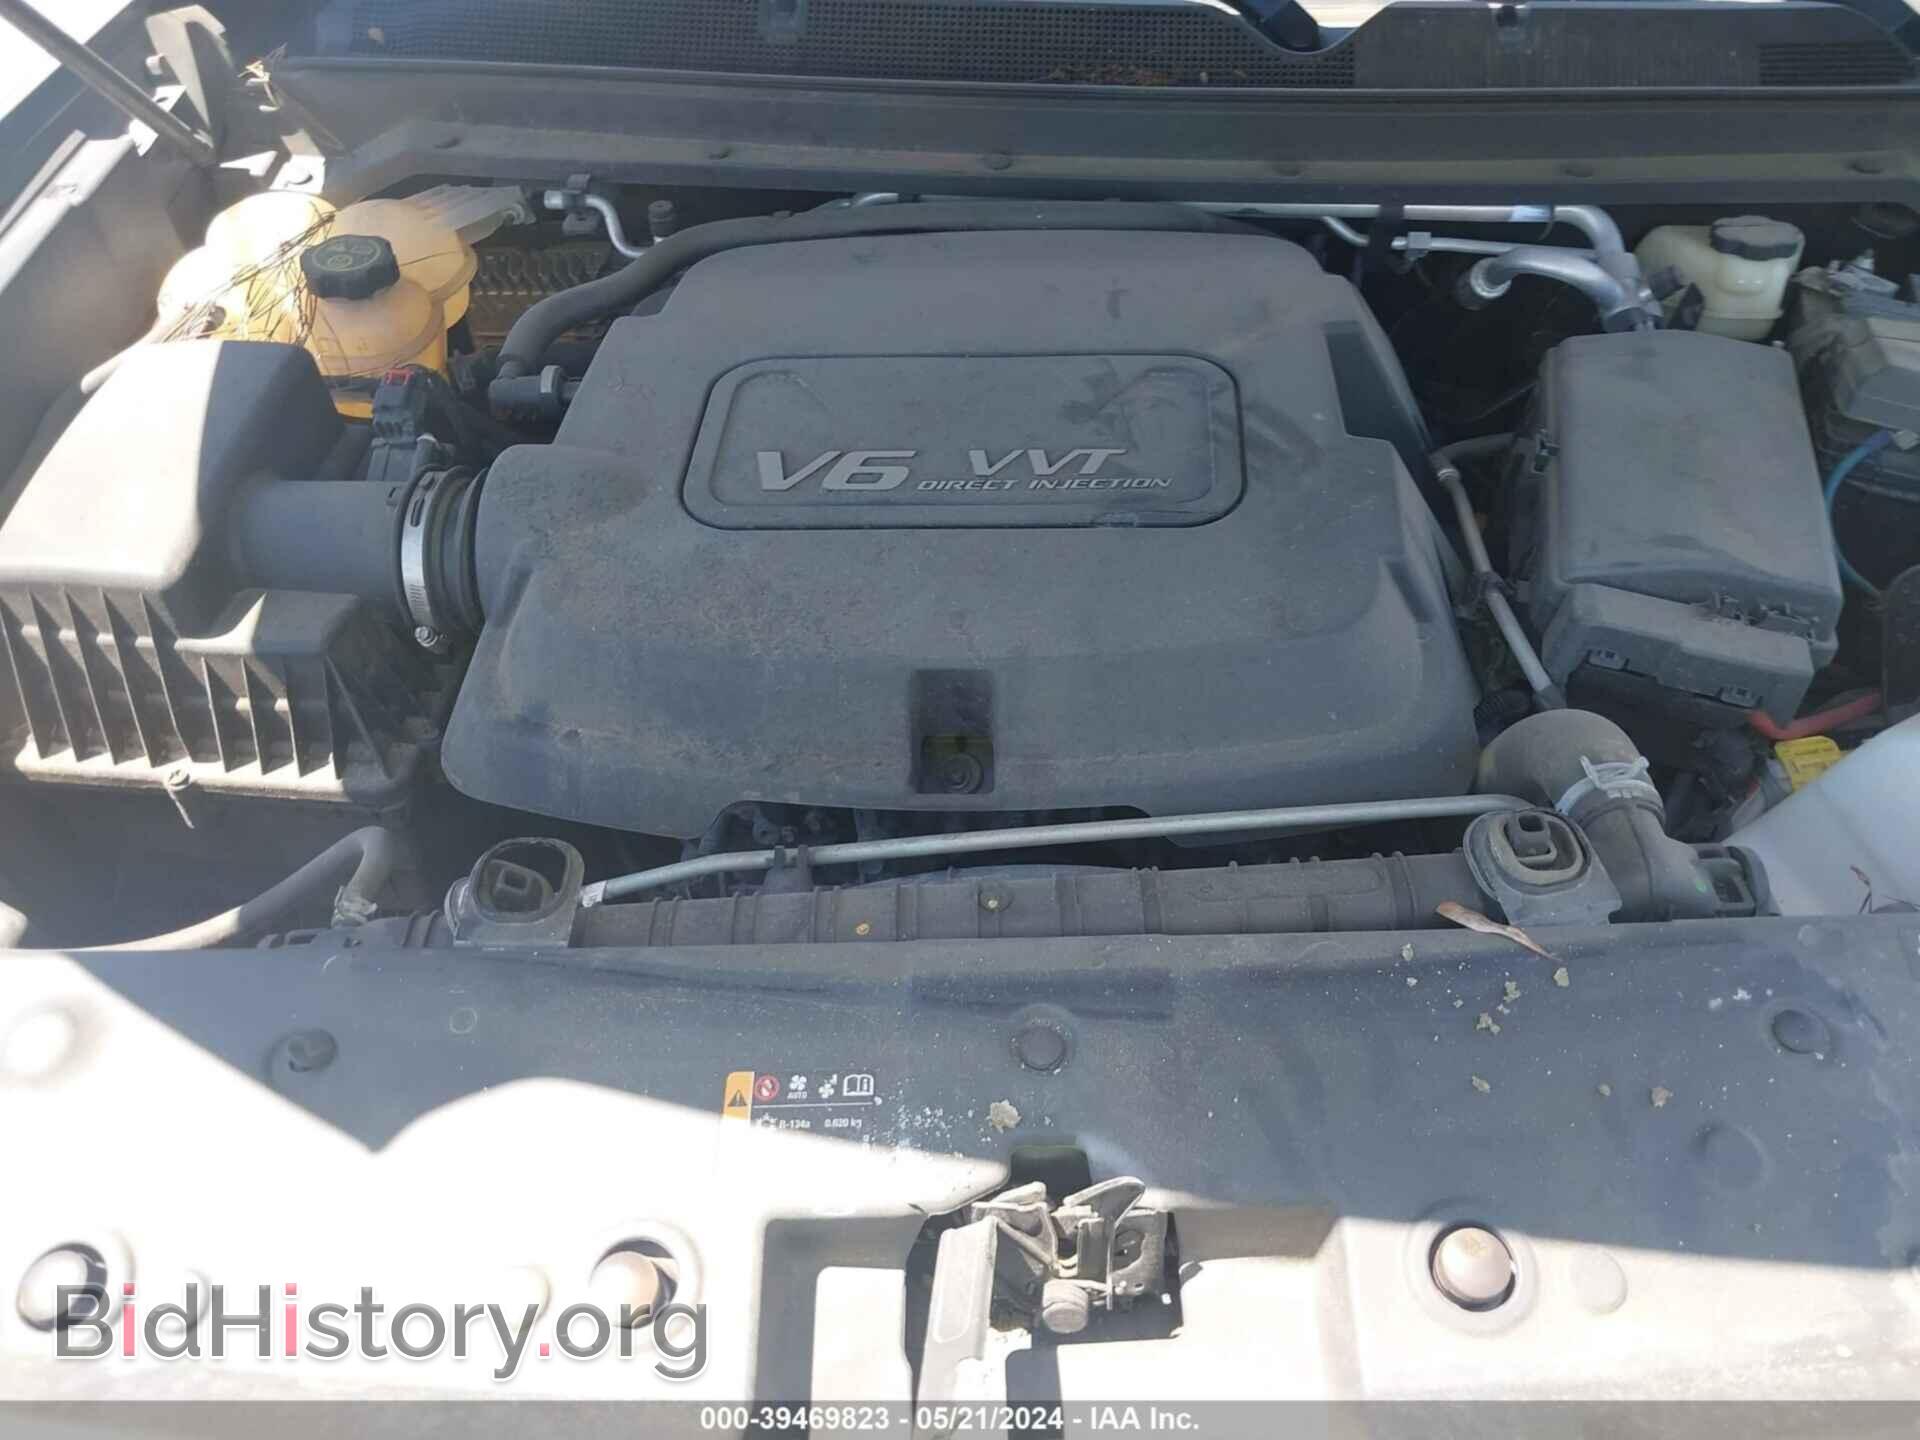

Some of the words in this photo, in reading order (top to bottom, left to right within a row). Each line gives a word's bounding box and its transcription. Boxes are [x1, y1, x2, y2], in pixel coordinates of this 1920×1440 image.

[756, 450, 917, 491] V6
[968, 449, 1127, 475] VVT
[917, 479, 1017, 490] DIRECT
[1028, 478, 1171, 490] INJECTION
[787, 1091, 808, 1099] AUTO
